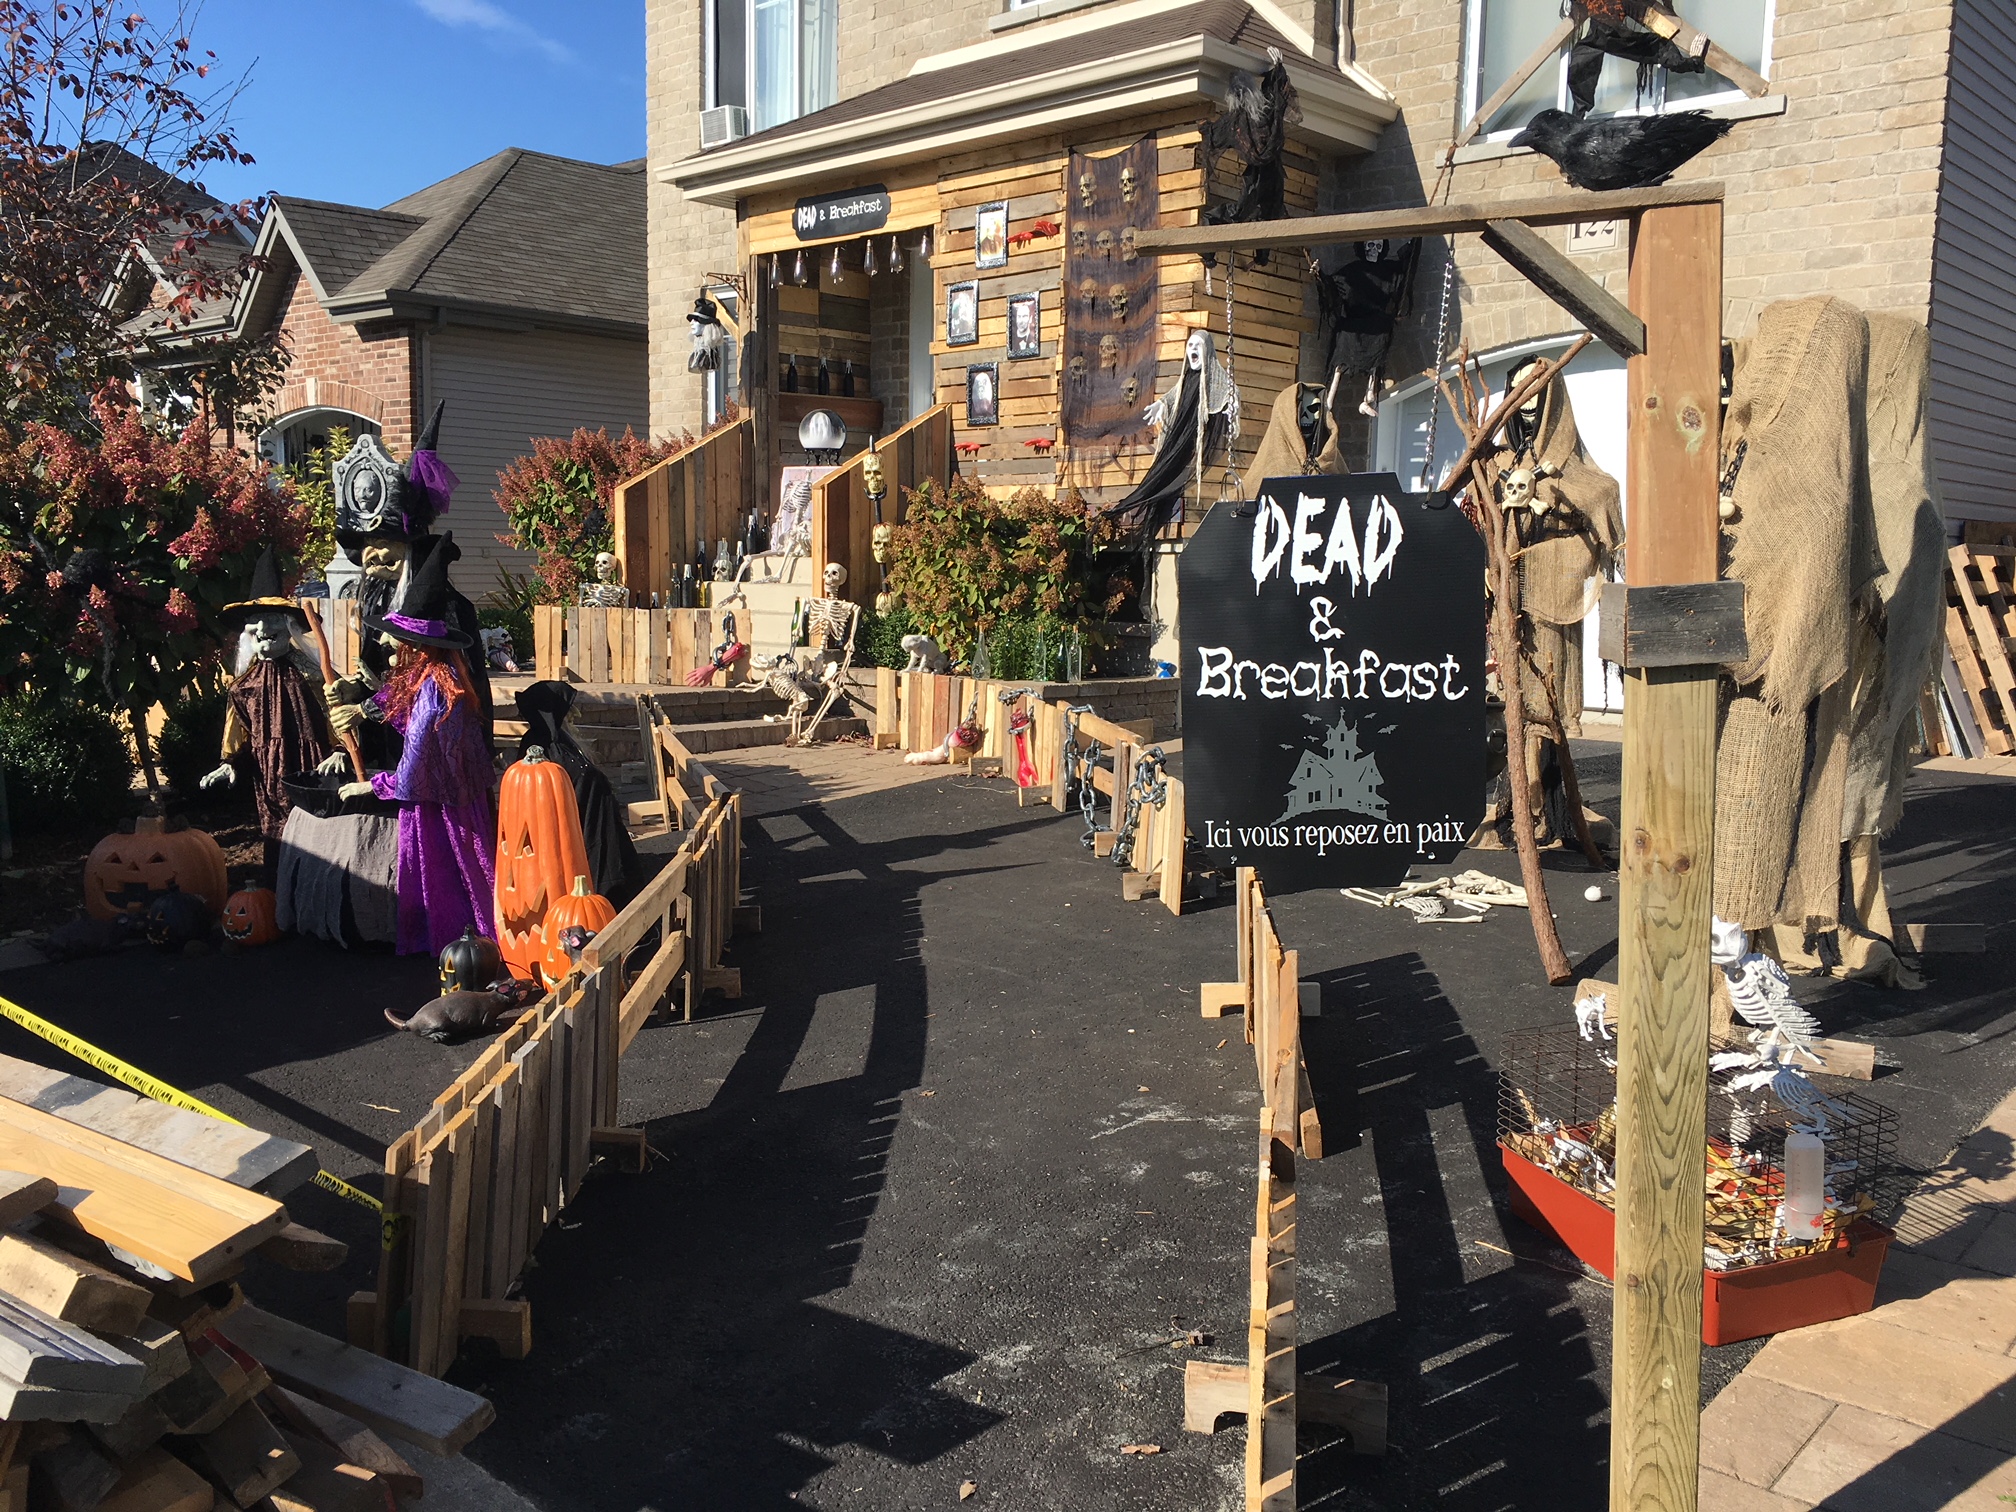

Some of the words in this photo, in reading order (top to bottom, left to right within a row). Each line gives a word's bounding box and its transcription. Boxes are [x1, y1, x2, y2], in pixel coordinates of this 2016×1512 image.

[797, 204, 817, 231] DEAD
[819, 209, 826, 222] &
[829, 198, 883, 220] Breakfast
[1251, 491, 1404, 598] DEAD
[1309, 596, 1345, 642] &
[1196, 646, 1469, 703] Breakfast
[1204, 820, 1233, 849] Ici
[1237, 824, 1289, 848] vous
[1293, 823, 1380, 856] reposez
[1383, 823, 1412, 844] en
[1416, 814, 1466, 853] paix
